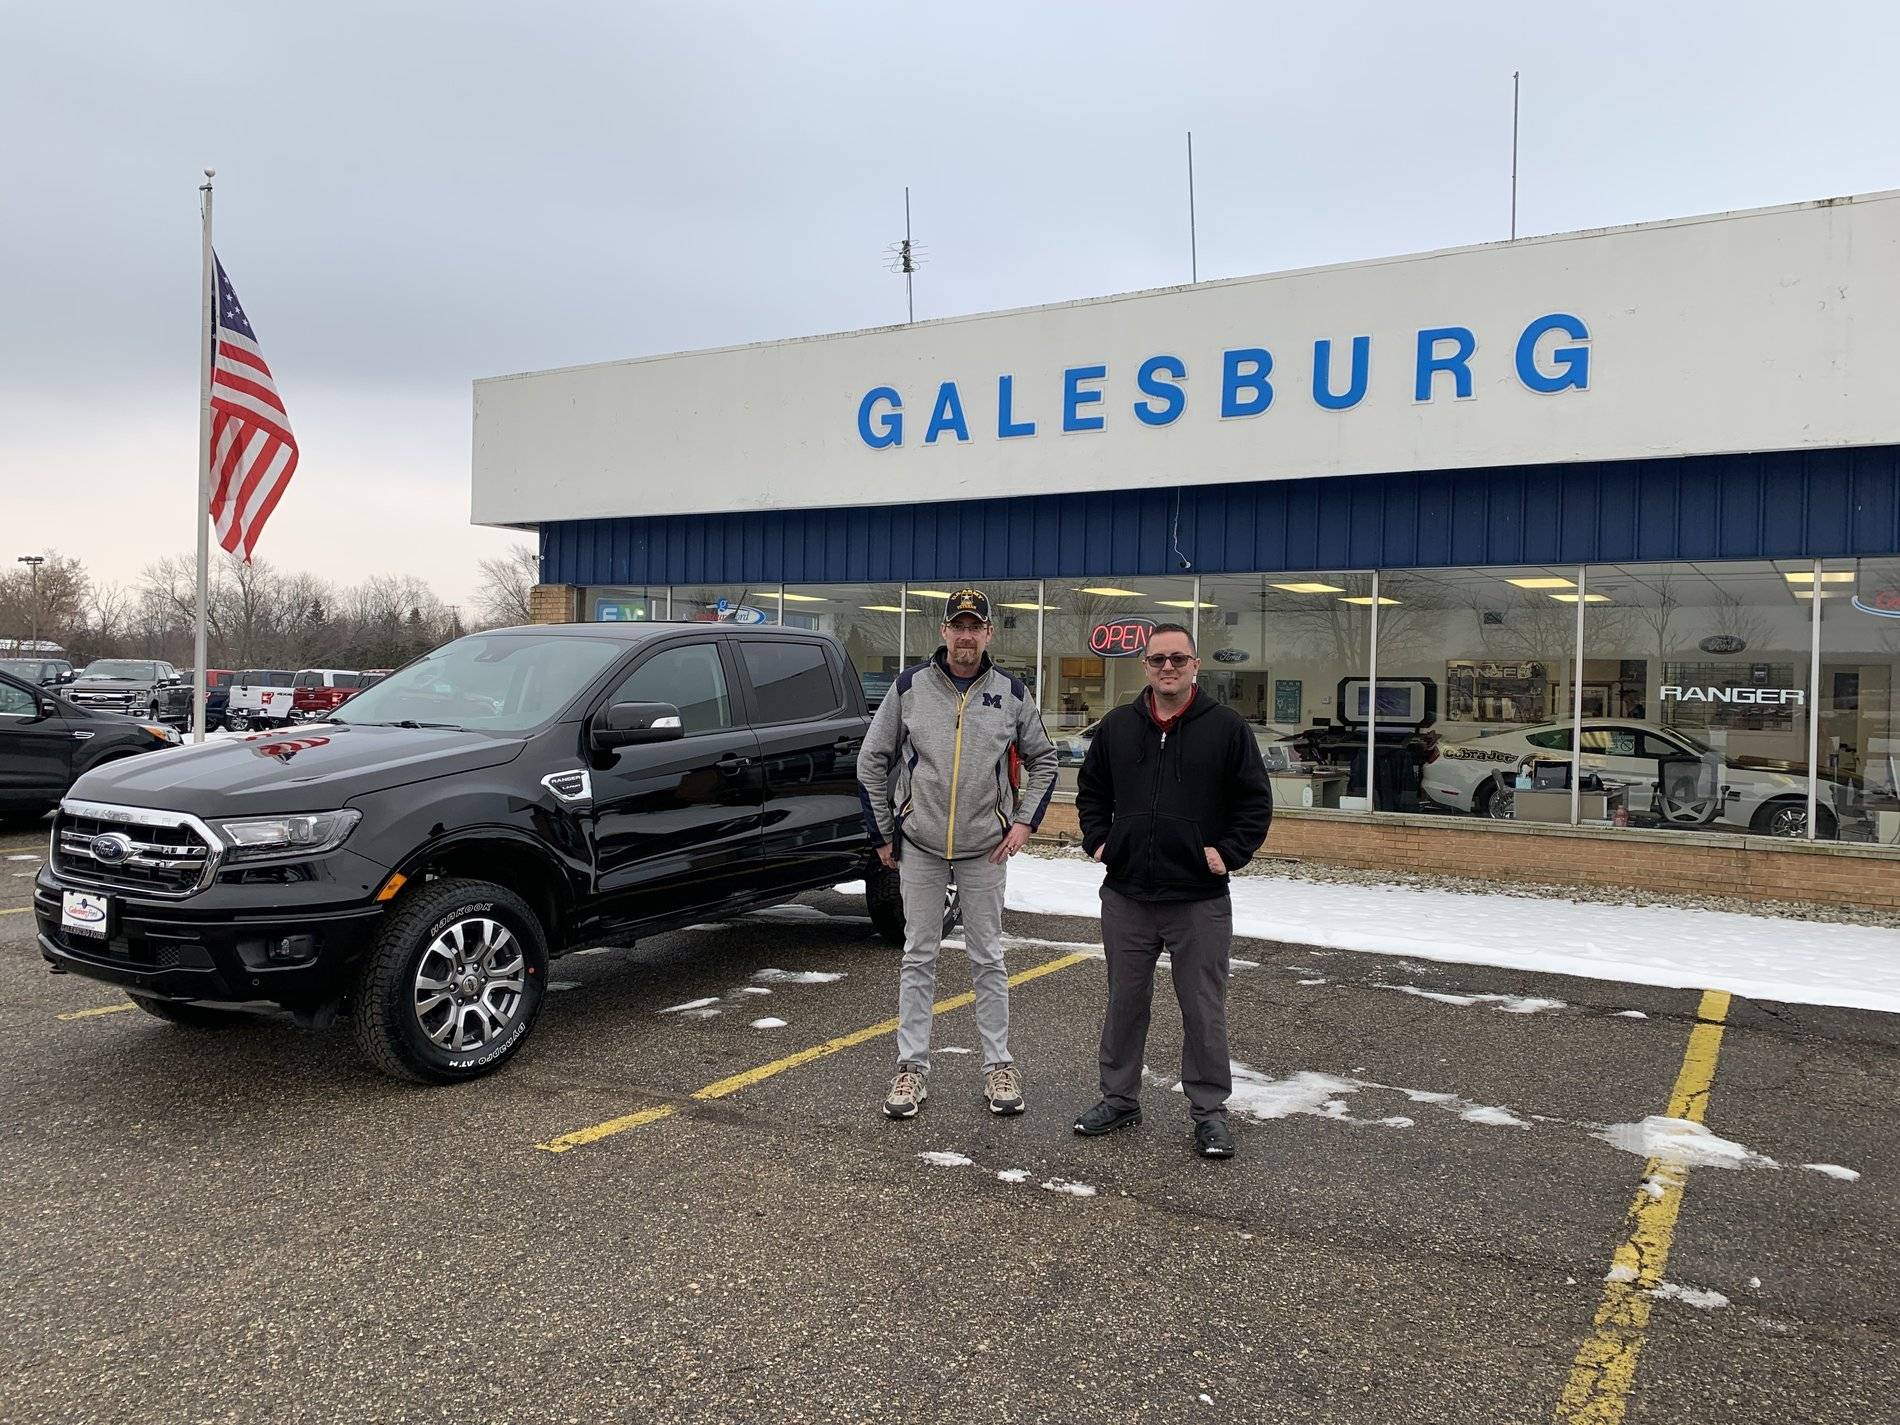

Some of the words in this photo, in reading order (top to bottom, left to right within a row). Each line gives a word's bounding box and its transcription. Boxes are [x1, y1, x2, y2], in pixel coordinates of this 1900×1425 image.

[857, 313, 1591, 449] GALESBURG
[1091, 624, 1153, 649] OPEN
[1710, 637, 1736, 651] Ford
[1219, 651, 1242, 662] Ford
[982, 692, 1002, 709] M
[1660, 685, 1805, 705] RANGER
[95, 840, 116, 857] Ford
